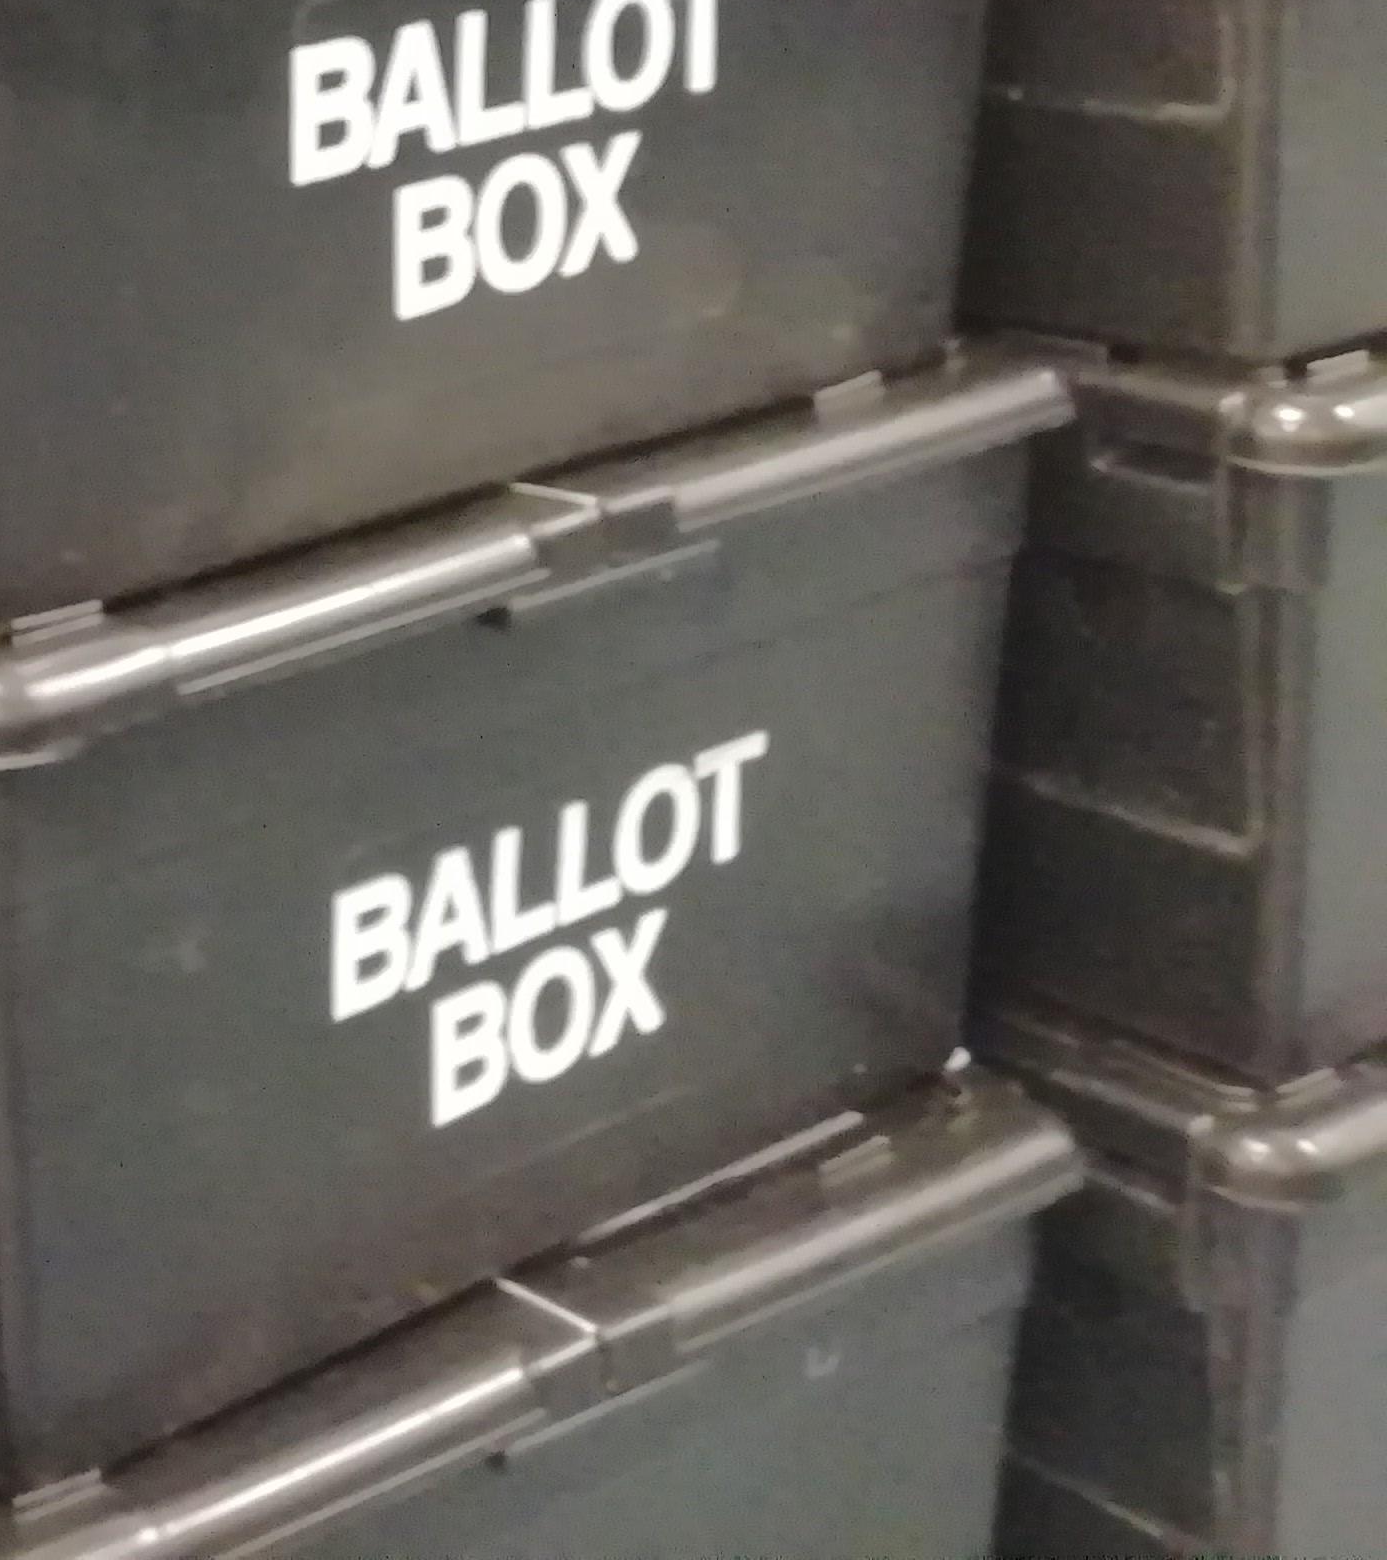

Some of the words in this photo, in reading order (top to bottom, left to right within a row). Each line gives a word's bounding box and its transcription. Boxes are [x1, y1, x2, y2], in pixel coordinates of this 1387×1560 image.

[394, 132, 640, 320] BOX
[332, 732, 767, 1021] BALLOT
[432, 909, 667, 1126] BOX
